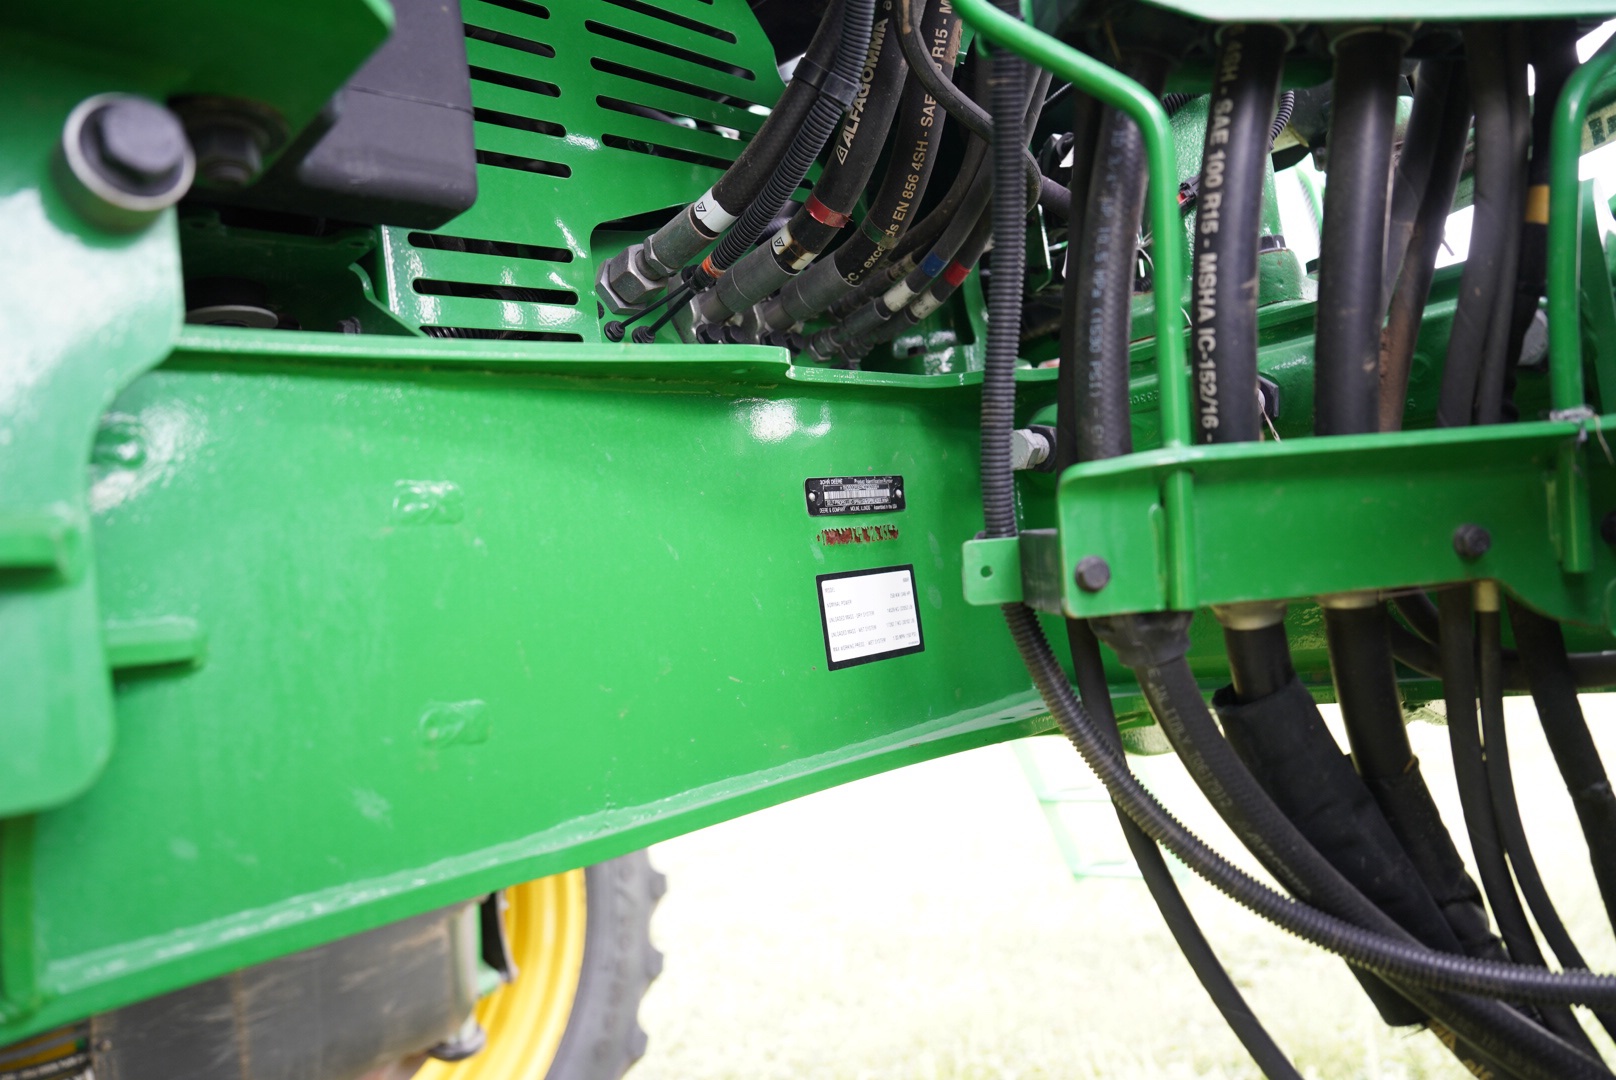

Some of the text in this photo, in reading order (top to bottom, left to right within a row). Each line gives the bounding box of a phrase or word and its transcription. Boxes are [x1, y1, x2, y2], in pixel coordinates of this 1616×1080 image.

[932, 28, 949, 58] R15
[842, 18, 889, 148] ALFAGOMMA
[1210, 98, 1233, 146] SAE
[863, 223, 900, 269] exceds
[893, 201, 910, 221] EN
[902, 174, 919, 199] 856
[911, 141, 929, 171] 4SH
[921, 94, 938, 127] SAE
[1205, 151, 1226, 189] 100
[1201, 192, 1222, 235] R15
[1198, 252, 1217, 322] MSHA
[1198, 327, 1219, 430] IC-152/16
